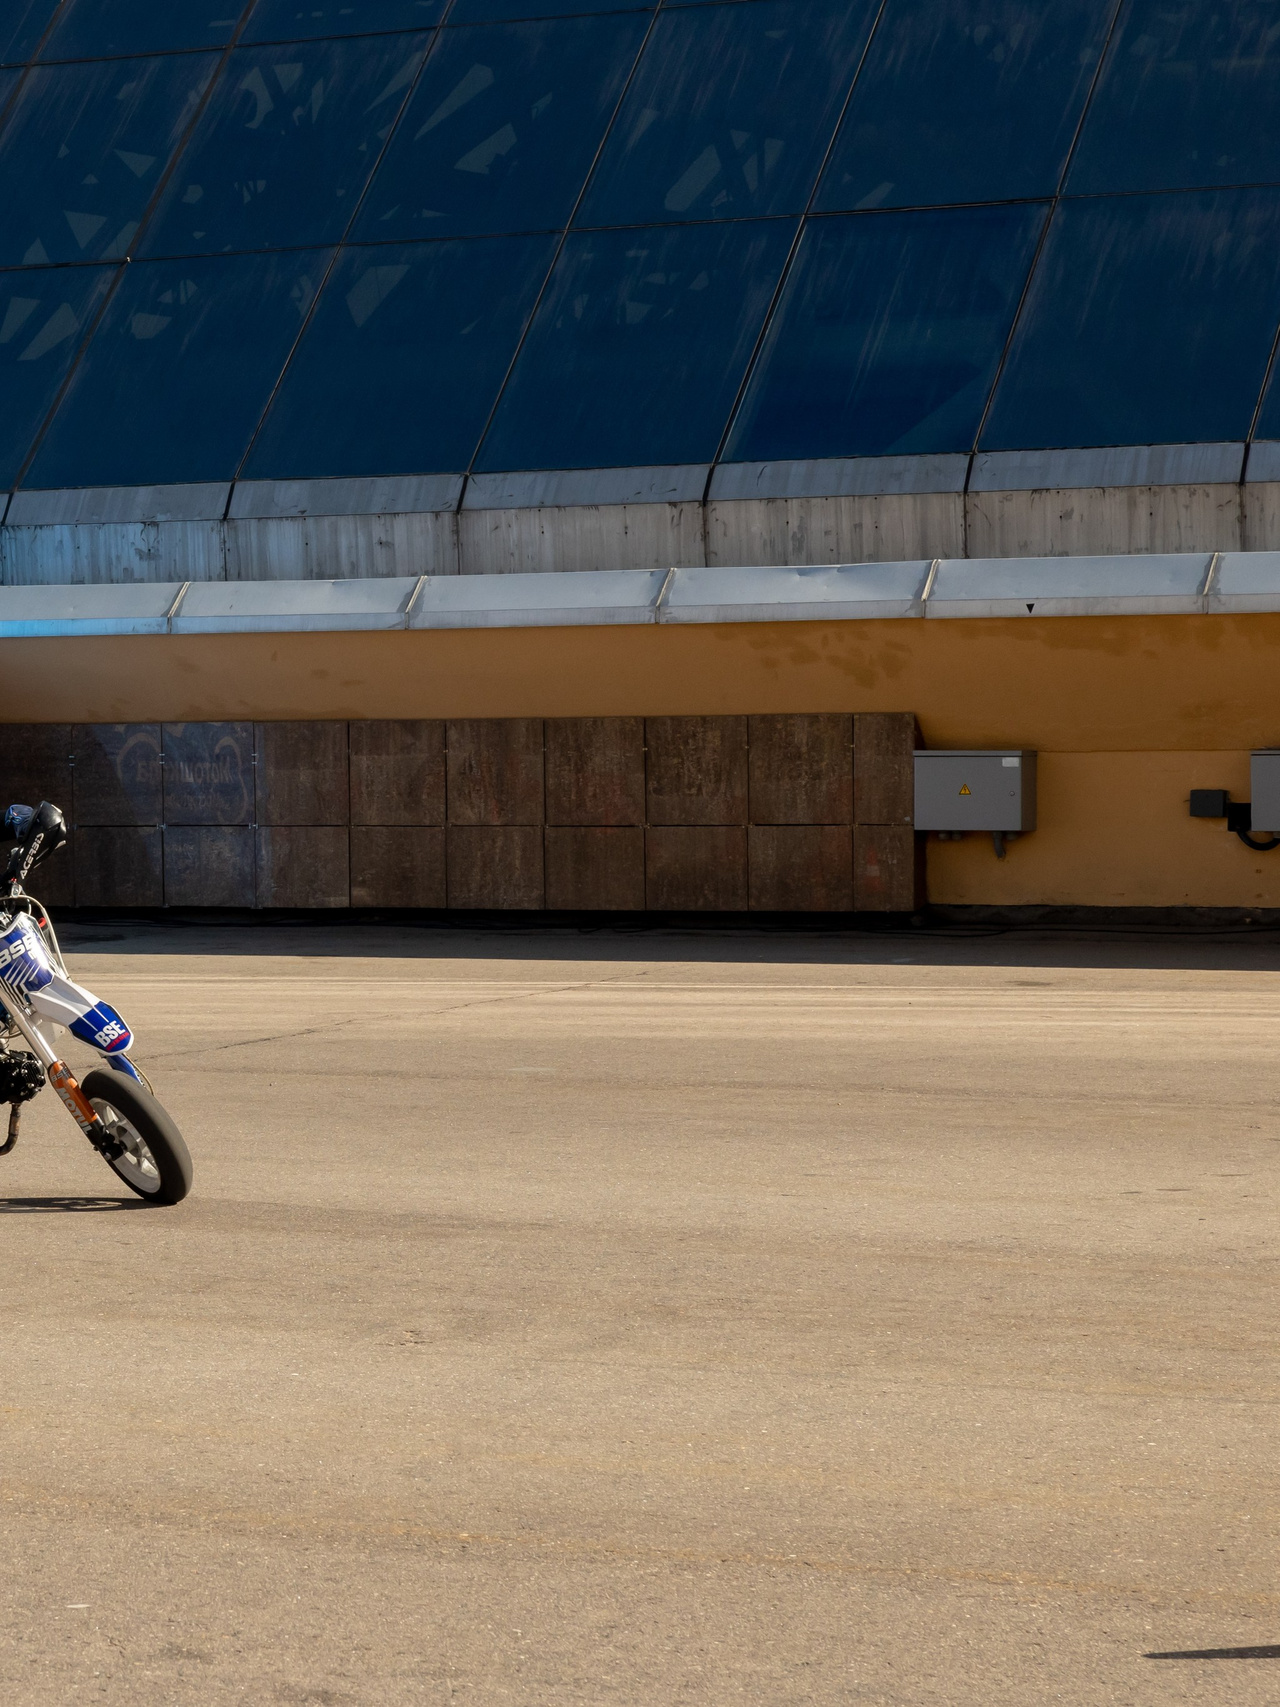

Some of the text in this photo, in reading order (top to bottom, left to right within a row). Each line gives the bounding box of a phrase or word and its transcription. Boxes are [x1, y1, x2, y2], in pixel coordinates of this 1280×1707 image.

[20, 833, 45, 879] ACERBIS
[94, 1020, 126, 1048] BSE
[56, 1088, 92, 1135] MOTUL
